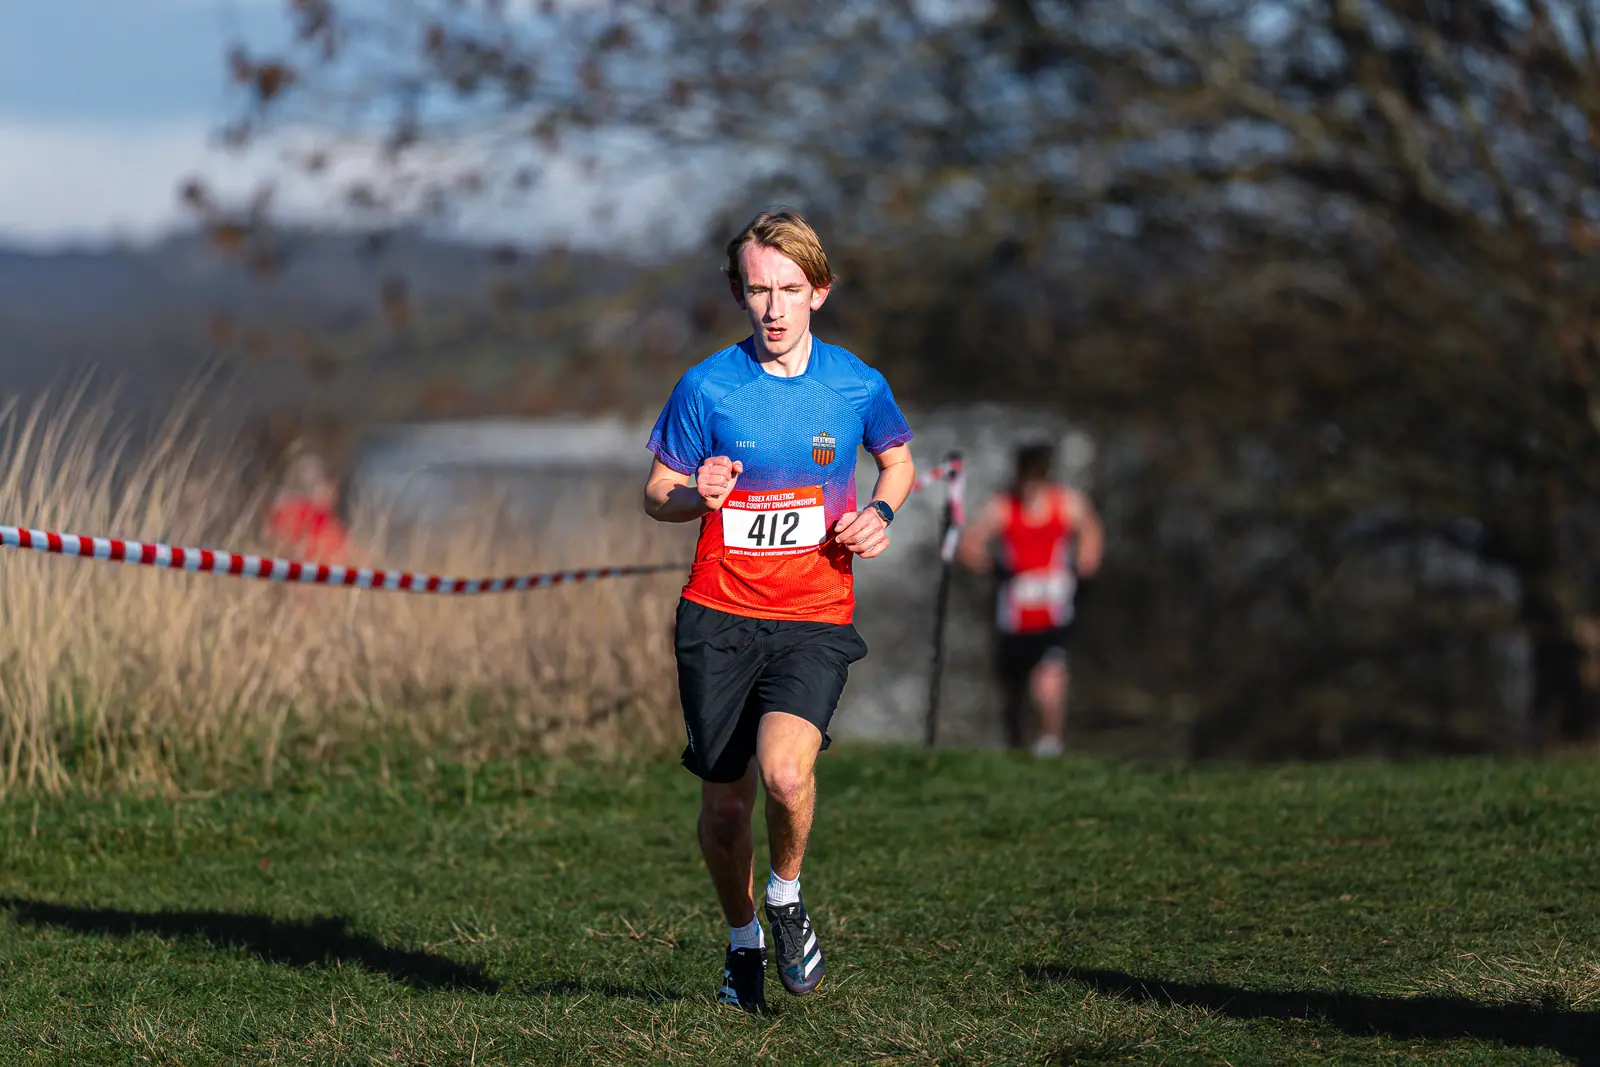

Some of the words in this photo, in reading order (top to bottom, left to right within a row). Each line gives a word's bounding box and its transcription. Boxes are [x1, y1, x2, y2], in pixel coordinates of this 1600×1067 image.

[736, 440, 755, 448] TACTIC
[766, 492, 795, 501] ATHLETICS
[728, 500, 746, 508] CROSS
[772, 497, 817, 508] CHAMPIONSHIPS
[747, 511, 800, 546] 412
